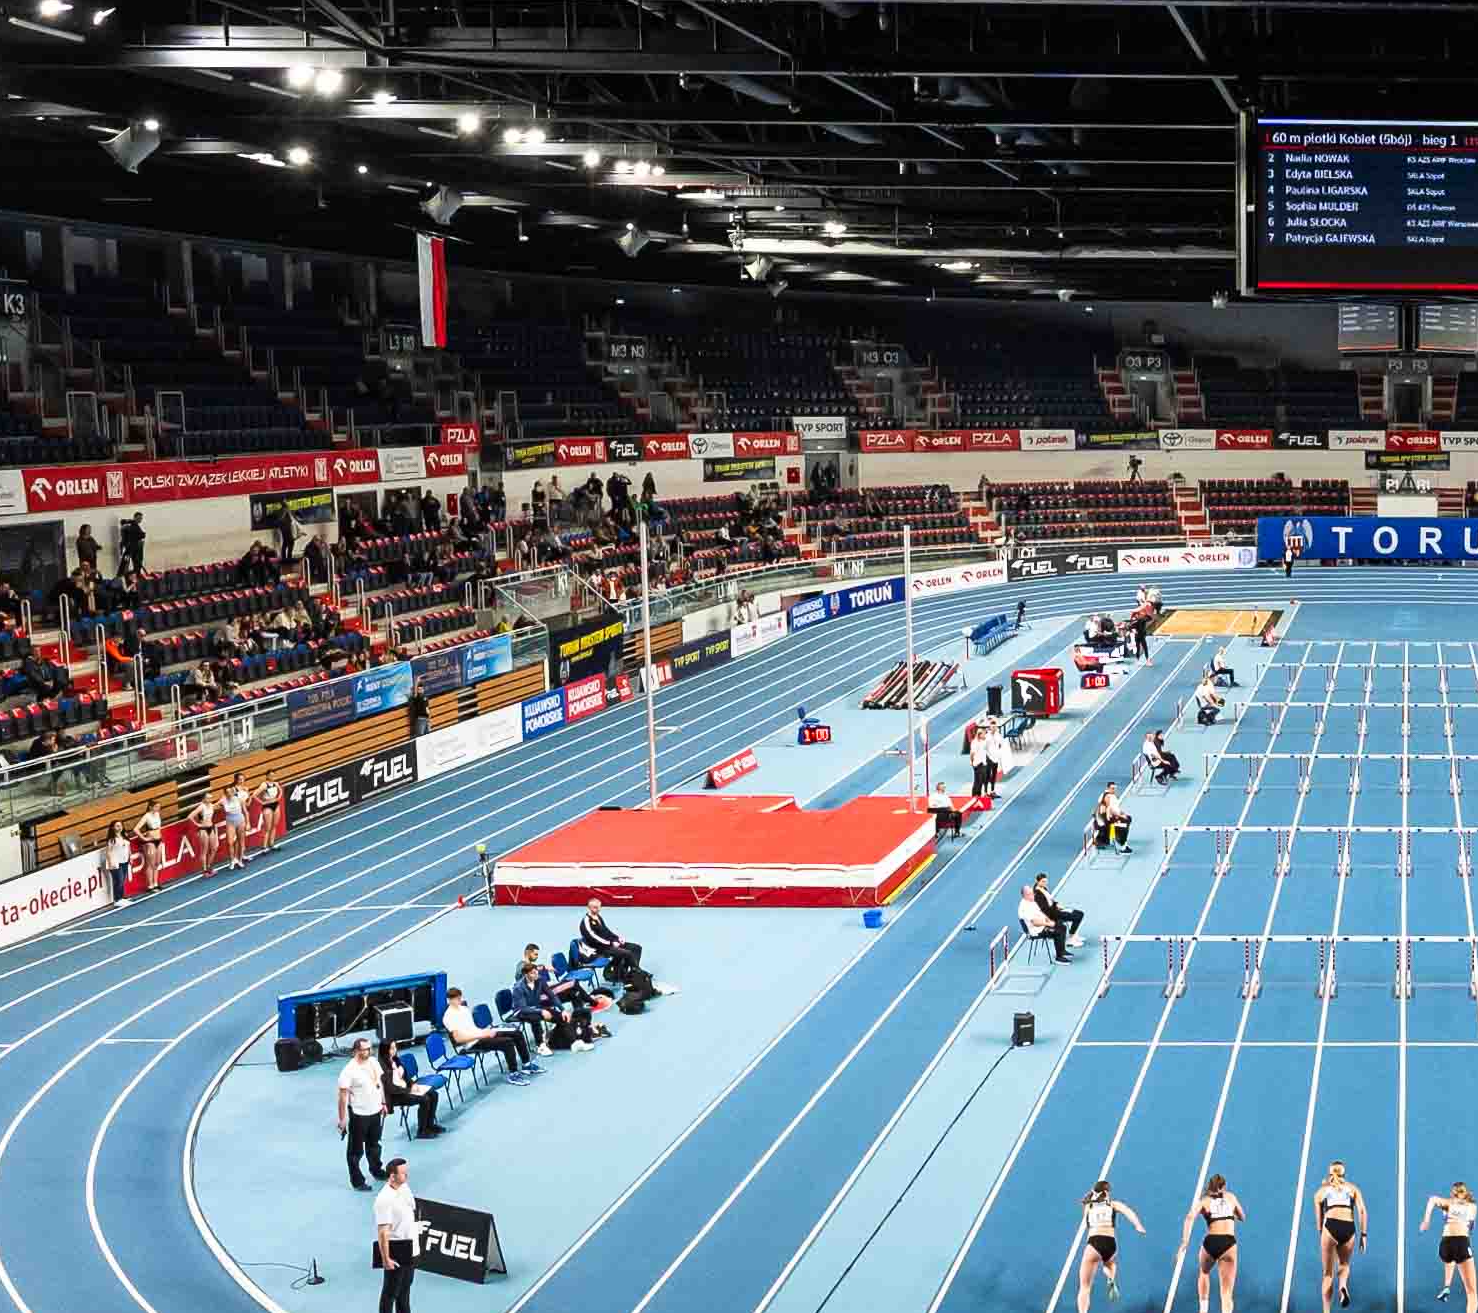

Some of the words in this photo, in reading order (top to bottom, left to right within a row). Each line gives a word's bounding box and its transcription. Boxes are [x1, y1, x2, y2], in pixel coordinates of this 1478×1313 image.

[1272, 132, 1287, 143] 60
[1289, 134, 1301, 143] m
[1339, 133, 1376, 144] Kobiet
[1422, 134, 1447, 148] bieg
[1450, 135, 1457, 146] 1
[4, 293, 25, 314] K3
[793, 422, 814, 433] TVP
[815, 421, 844, 433] SPORT
[447, 428, 477, 443] PZLA
[866, 433, 906, 446] PZLA
[972, 432, 1013, 445] PZLA
[1288, 434, 1322, 446] FUEL
[1406, 436, 1437, 446] ORLEN
[1442, 436, 1461, 447] TVP
[569, 444, 592, 457] ORLEN
[615, 443, 639, 457] FUEL
[661, 441, 687, 453] ORLEN
[752, 437, 781, 450] ORLEN
[349, 458, 377, 474] ORLEN
[440, 452, 464, 467] ORLEN
[133, 474, 174, 490] POLSKI
[268, 465, 310, 481] ATLETYKI
[55, 476, 99, 496] ORLEN
[1077, 554, 1113, 570] FUEL
[1138, 555, 1171, 565] ORLEN
[1197, 552, 1230, 563] ORLEN
[975, 567, 1004, 580] ORLEN
[1021, 559, 1058, 575] FUEL
[925, 575, 953, 588] ORLEN
[848, 581, 893, 609] TORUŃ
[803, 728, 829, 743] 1:00
[375, 754, 412, 789] FUEL
[305, 777, 350, 814] FUEL
[425, 1228, 484, 1263] FUEL
